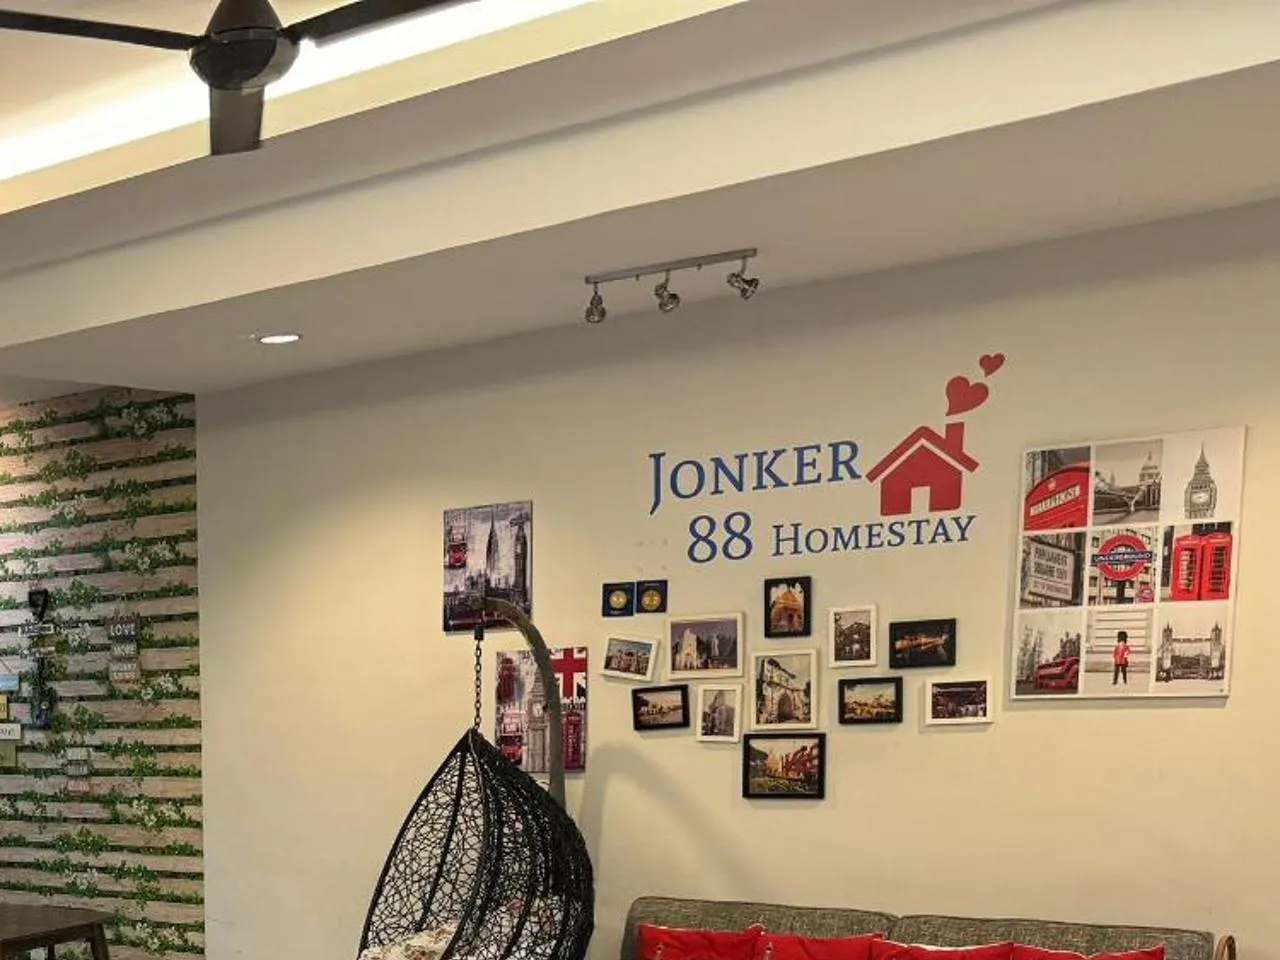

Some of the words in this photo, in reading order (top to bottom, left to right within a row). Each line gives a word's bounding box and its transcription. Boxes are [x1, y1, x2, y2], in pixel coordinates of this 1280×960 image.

[648, 439, 863, 515] JONKER
[687, 511, 753, 563] 88
[772, 515, 976, 556] HOMESTAY
